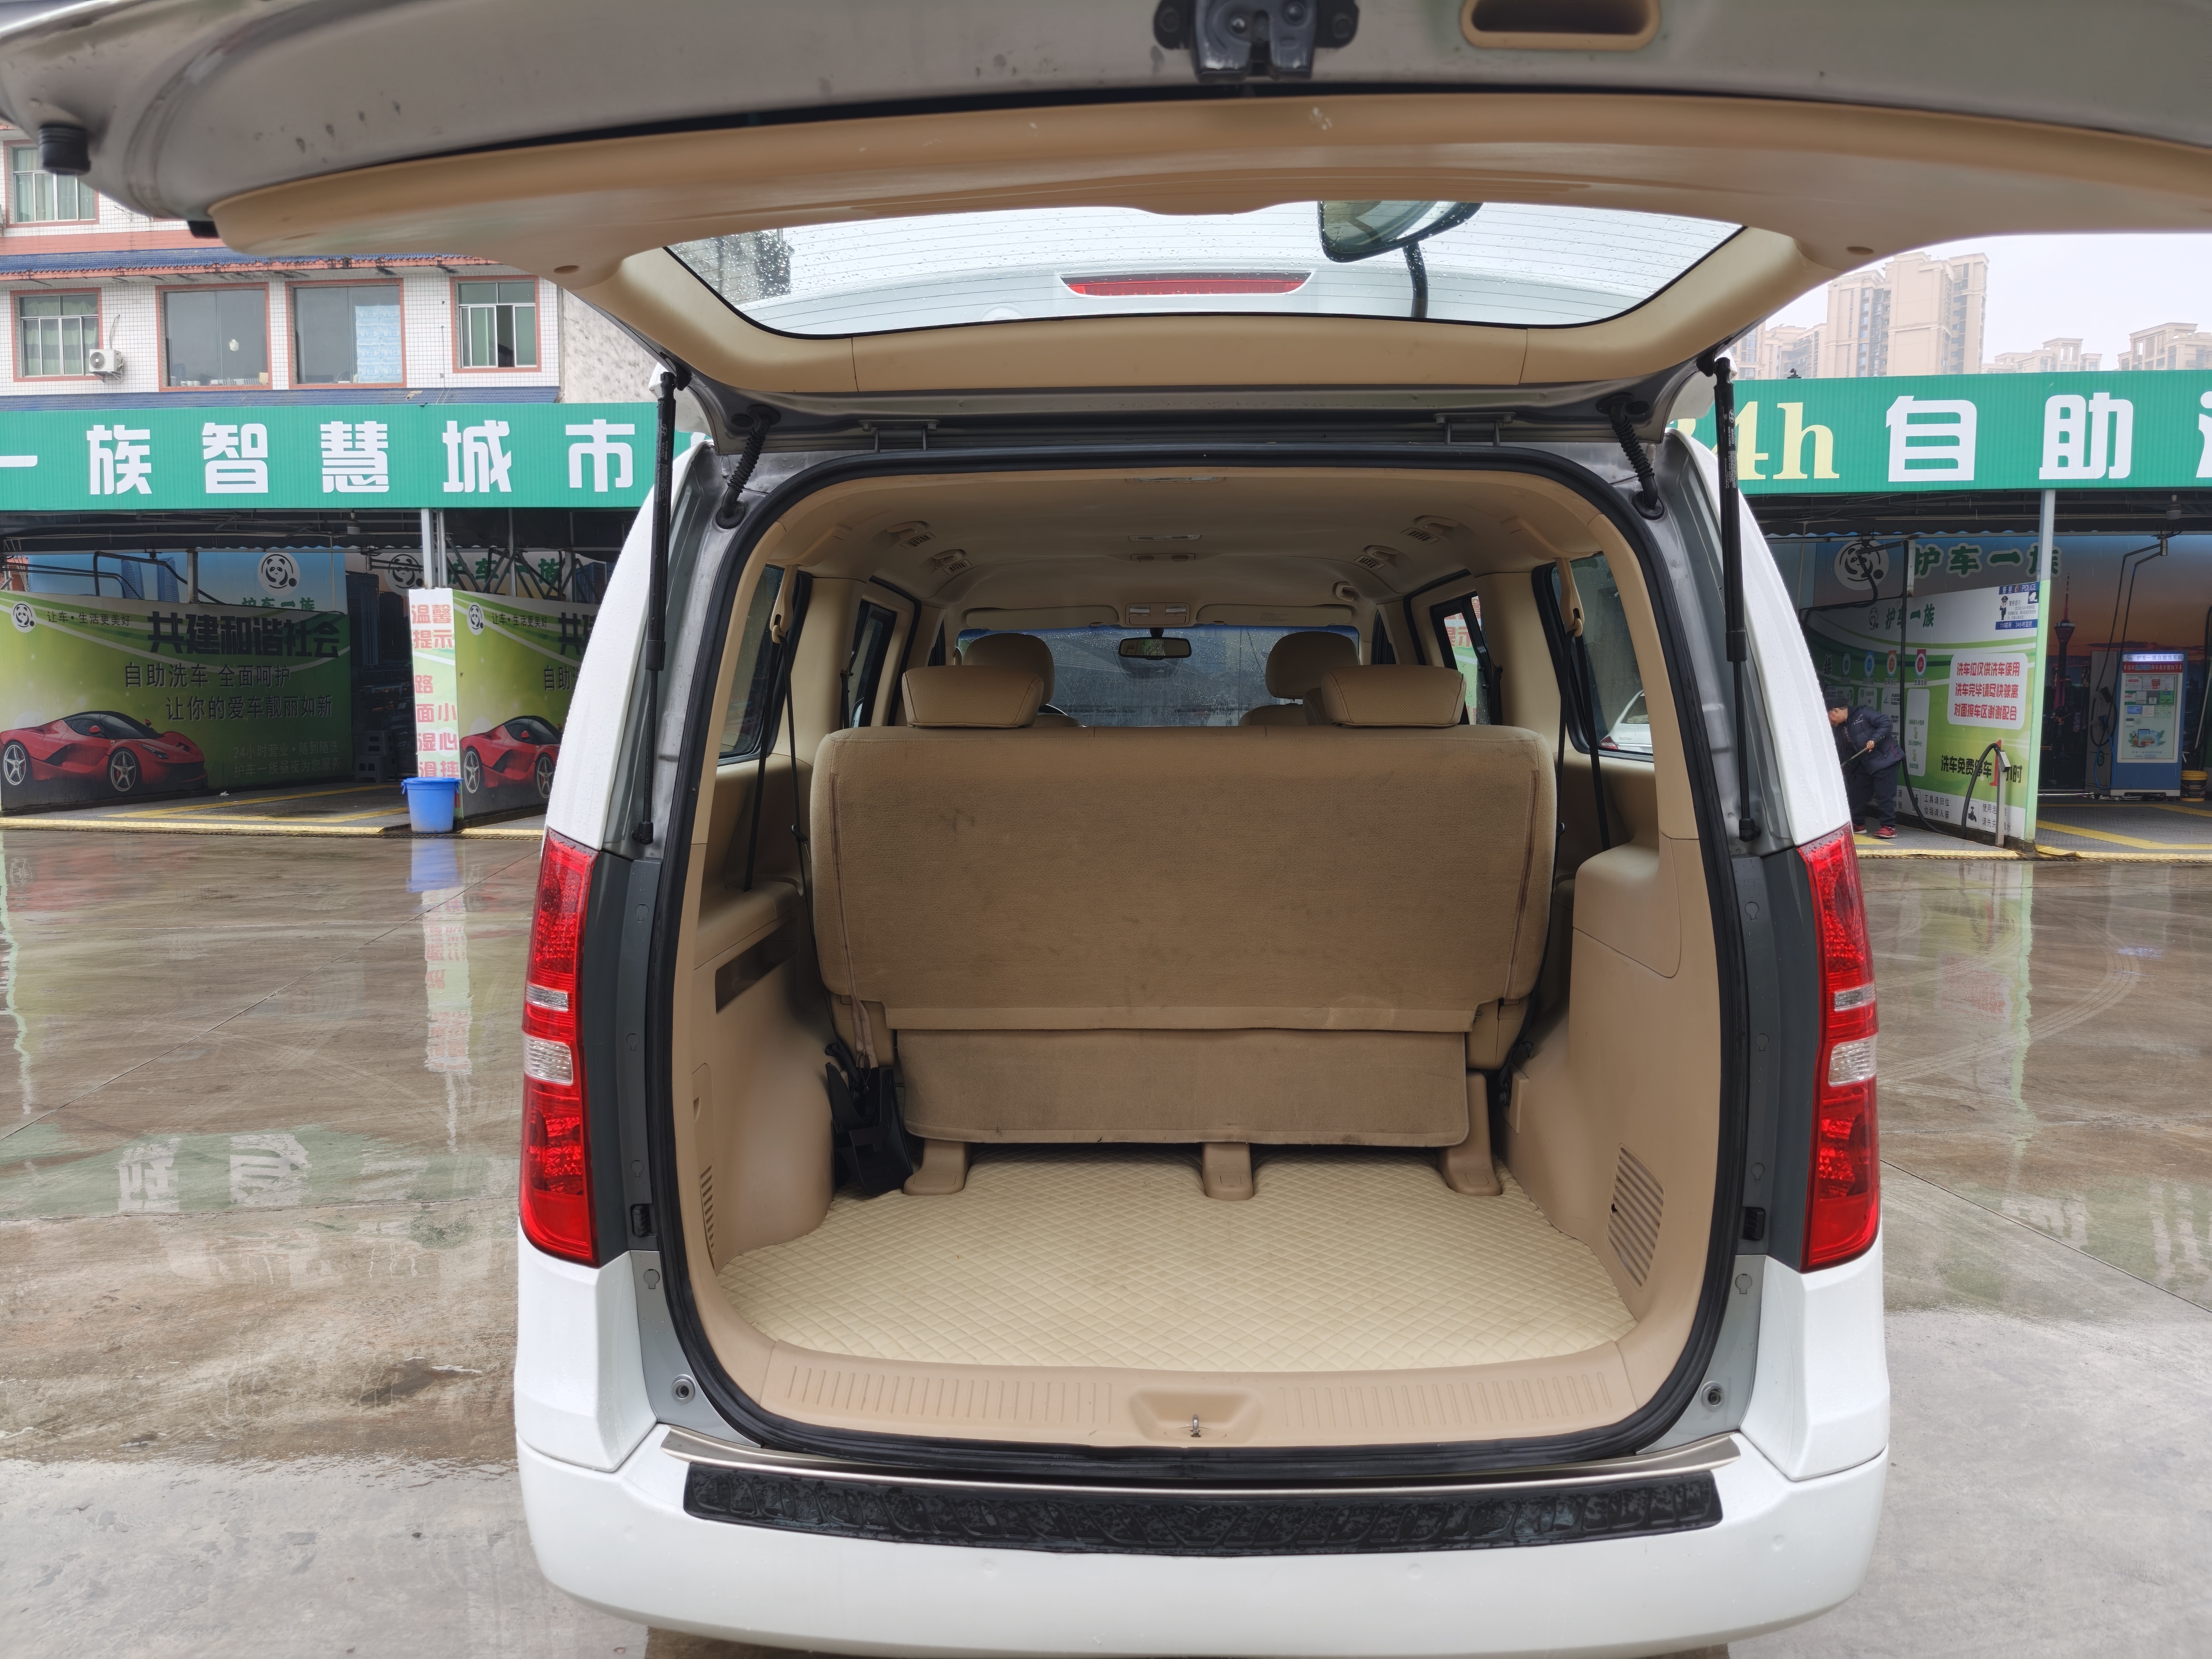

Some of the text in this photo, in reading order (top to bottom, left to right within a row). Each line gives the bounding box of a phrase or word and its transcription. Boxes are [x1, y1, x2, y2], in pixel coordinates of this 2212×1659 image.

[1668, 400, 1840, 480] 4h
[1885, 392, 2212, 482] 自助
[0, 419, 635, 495] 一族智慧城市
[1914, 544, 2060, 577] 护车一族
[412, 604, 452, 624] 温馨
[147, 610, 340, 658] 共建和谐社会
[412, 630, 453, 650] 提示
[125, 662, 291, 688] 自助洗车 全面呵护
[1957, 662, 2020, 677] 洗车位仅供洗车使用
[1955, 683, 2019, 698] 洗车完毕请尽快驶离
[166, 694, 332, 721] 让你的爱车靓丽如新
[1954, 703, 2017, 721] 对面擦车区谢谢配合
[234, 756, 341, 778] 护车一族昼夜为您服务
[1924, 794, 1950, 807] 工具请归位
